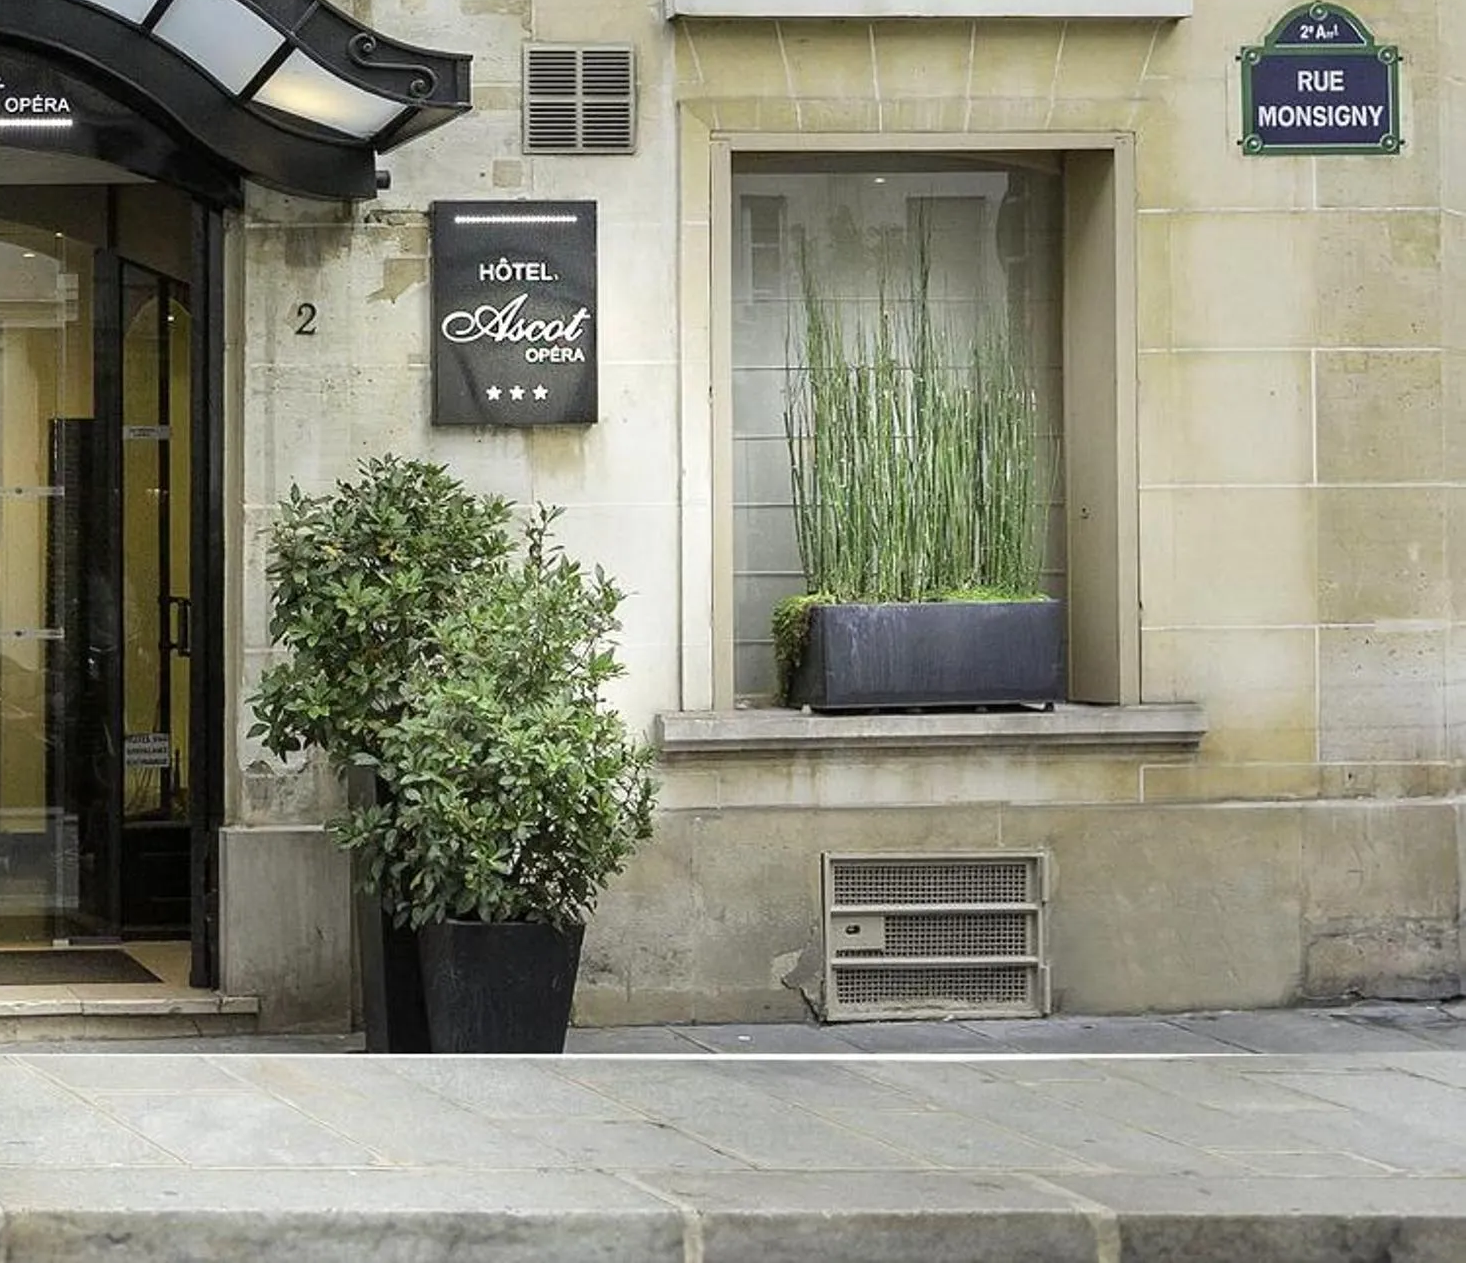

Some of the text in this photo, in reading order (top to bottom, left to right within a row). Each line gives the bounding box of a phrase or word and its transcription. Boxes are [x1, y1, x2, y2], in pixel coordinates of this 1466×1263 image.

[1297, 70, 1345, 92] RUE
[4, 93, 71, 113] OPÉRA
[1257, 105, 1384, 127] MONSIGNY
[479, 257, 553, 282] HÔTEL
[295, 303, 317, 335] 2
[442, 293, 591, 343] Ascot
[525, 345, 586, 363] OPÉRA
